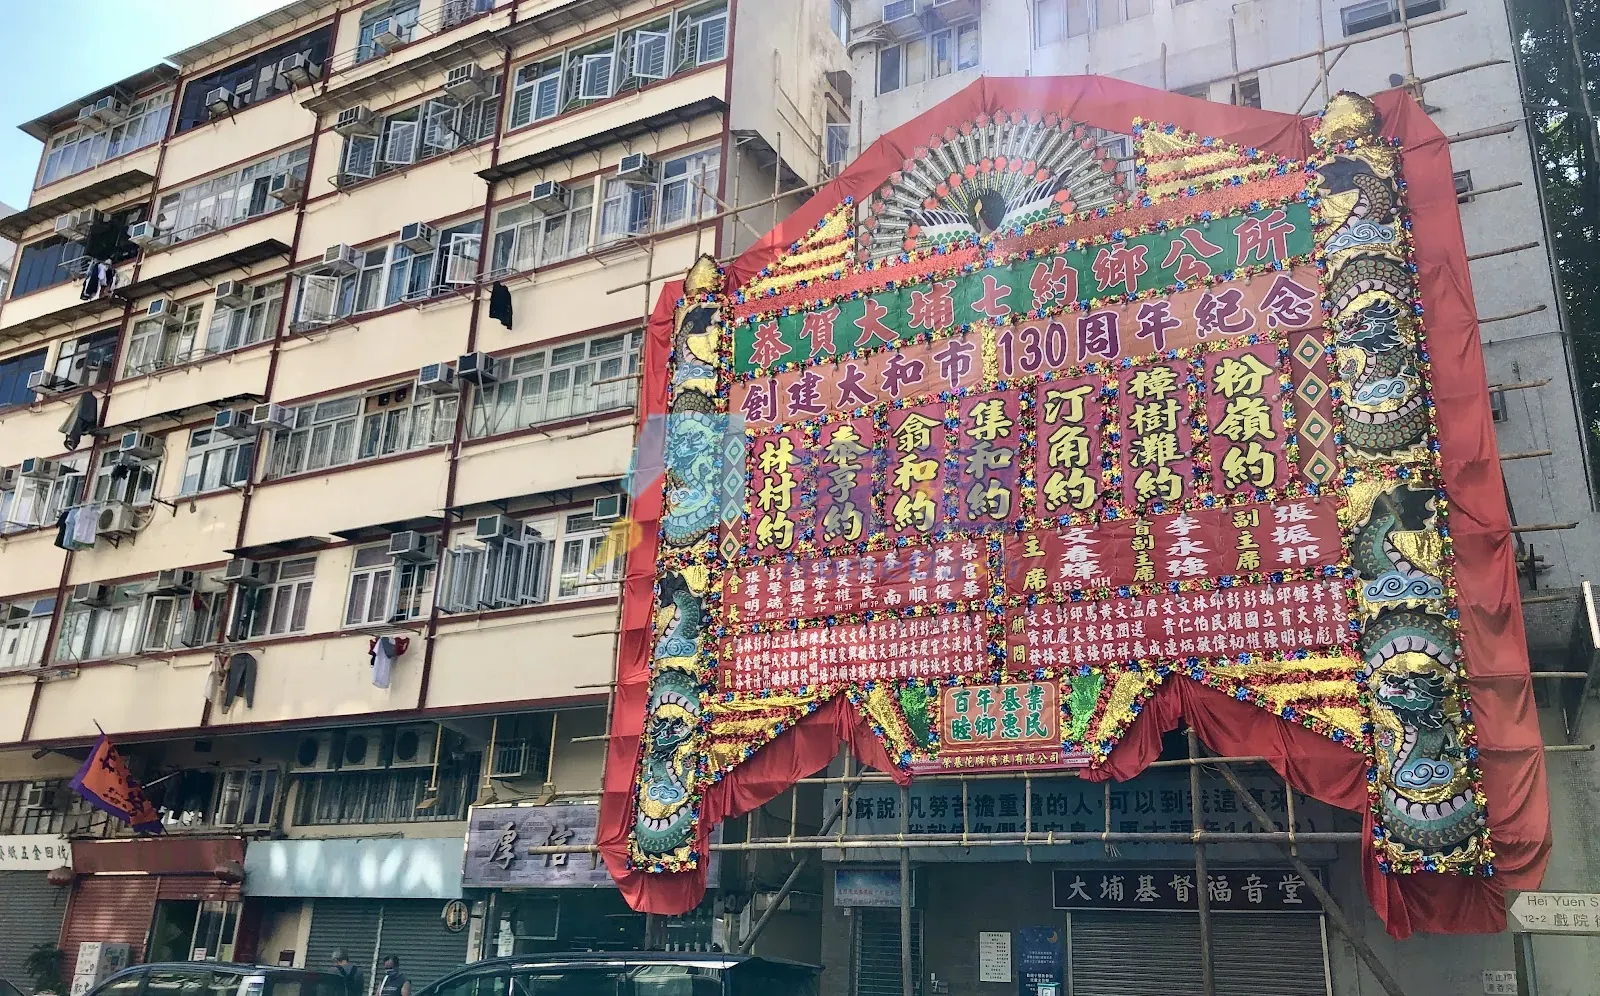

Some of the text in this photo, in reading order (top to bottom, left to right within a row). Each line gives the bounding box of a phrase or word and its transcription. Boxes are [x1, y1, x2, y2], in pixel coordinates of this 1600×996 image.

[749, 209, 1296, 369] 恭賀大埔七約鄉公所
[741, 274, 1317, 423] 創建太和市 130周年紀念
[1042, 385, 1098, 511] 汀角約
[1126, 366, 1186, 503] 樟樹灘約
[1210, 354, 1277, 490] 粉嶺約
[822, 424, 870, 543] 泰亨約
[965, 398, 1015, 520] 集和約
[755, 436, 801, 551] 林村約
[1021, 535, 1049, 592] 主席
[1058, 527, 1102, 580] 文春輝
[1165, 515, 1211, 578] 李永強
[1231, 508, 1262, 572] 副主席
[1271, 503, 1321, 566] 張振邦
[727, 574, 744, 624] 會長
[844, 603, 853, 611] JP
[1052, 576, 1111, 592] BBS MH
[951, 685, 1045, 713] 百年基業
[951, 712, 1048, 741] 睦鄉惠民
[1067, 874, 1306, 904] 大埔基督福音堂
[1524, 915, 1547, 923] 12-2
[1527, 895, 1548, 906] Hei
[1552, 895, 1586, 907] Yuen
